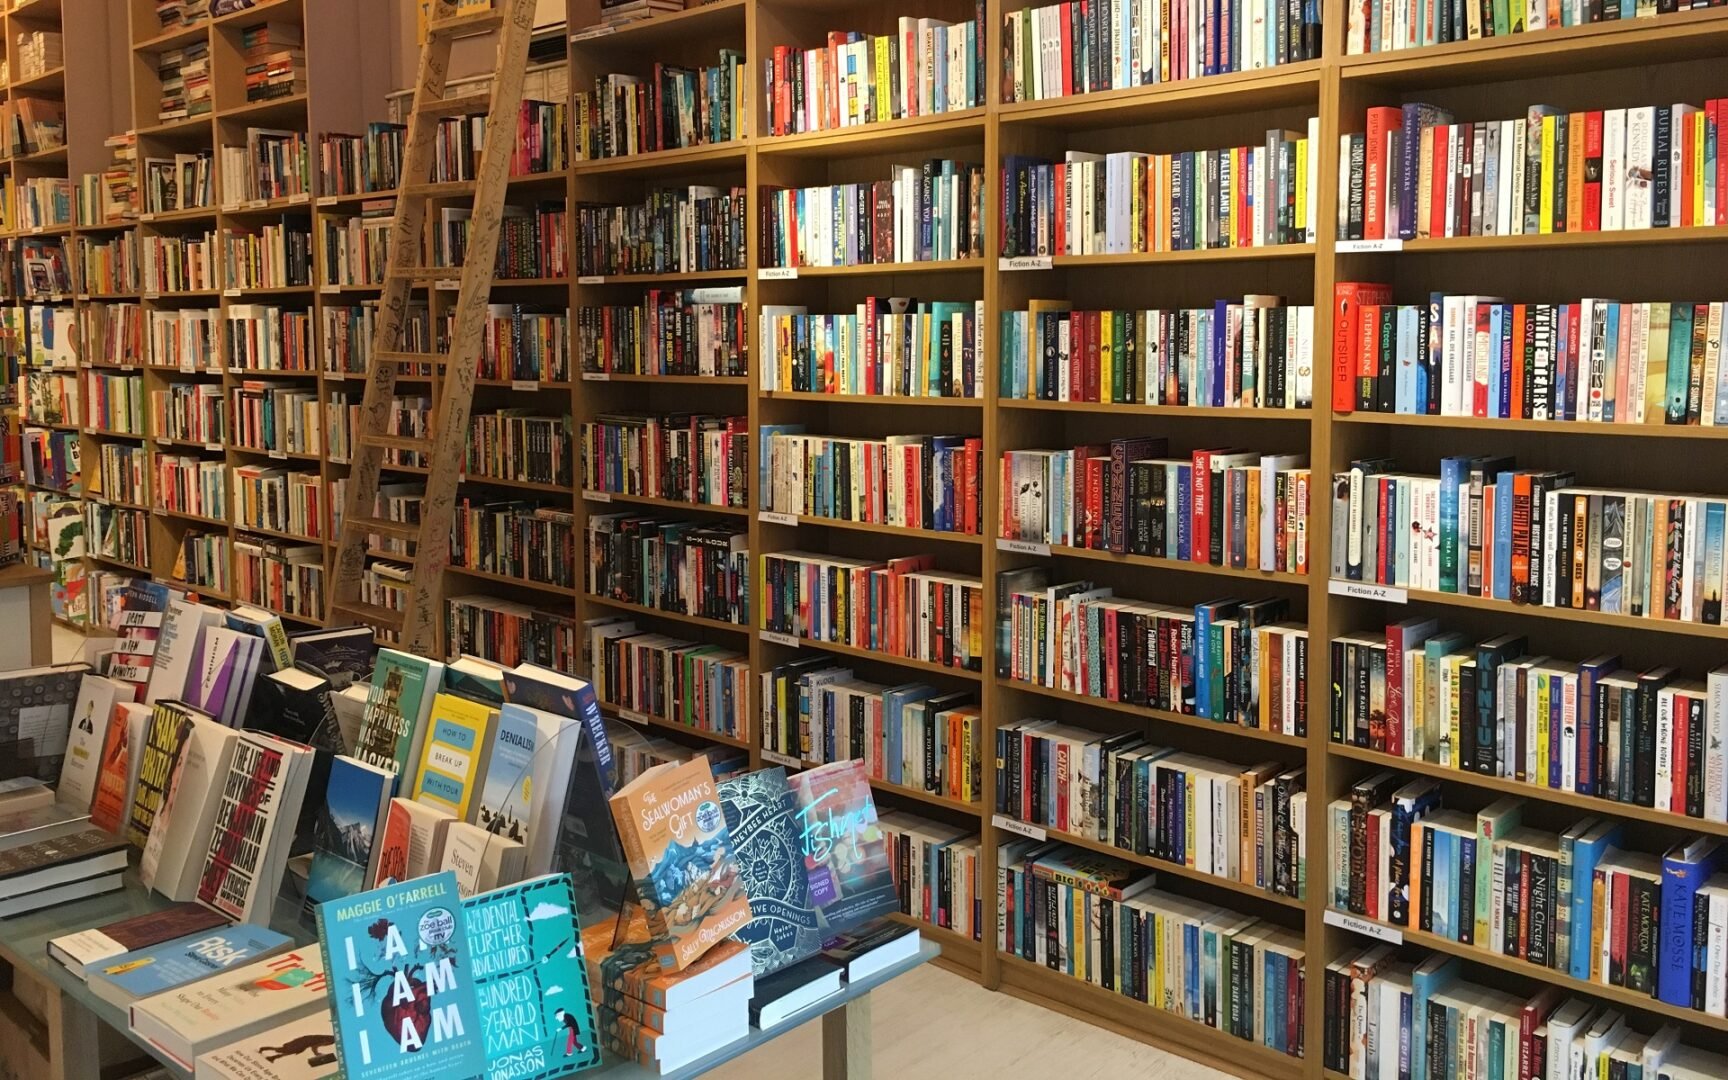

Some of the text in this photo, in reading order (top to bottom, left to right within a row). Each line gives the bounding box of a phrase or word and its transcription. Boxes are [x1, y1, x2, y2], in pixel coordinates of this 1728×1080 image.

[1657, 108, 1668, 195] BURIAL RITES
[923, 164, 931, 222] US AGAINST YOU
[1220, 153, 1230, 213] FALLEN LAND
[1608, 159, 1616, 209] Serious Sweet
[1363, 312, 1373, 352] STEPHEN
[1338, 319, 1349, 382] OUTSIDER
[1363, 353, 1373, 375] KING
[1534, 305, 1550, 409] WHITE TEARS
[1195, 456, 1204, 516] SHE'S NOT THERE
[1513, 494, 1529, 558] GRAFFITI PALACE
[1009, 543, 1027, 551] Fiction
[1347, 585, 1386, 598] Fiction A-Z
[125, 612, 146, 625] DEATH
[1210, 629, 1216, 638] OF
[128, 640, 140, 652] TEN
[269, 626, 281, 649] MORAN
[1148, 629, 1157, 666] Fatherland
[205, 636, 220, 690] FEMINISM
[1170, 628, 1178, 680] Robert Harris
[111, 666, 138, 679] MINUTES
[816, 675, 835, 686] KUDOS
[368, 684, 390, 706] YOUR
[1477, 652, 1492, 746] KINTU
[358, 724, 377, 746] WAS
[364, 703, 411, 738] HAPPINESS
[442, 727, 467, 742] HOW TO
[584, 702, 612, 767] WRECKER
[233, 742, 250, 774] THE
[435, 752, 463, 769] BREAK UP
[965, 744, 971, 753] GO
[965, 755, 971, 764] MY
[259, 790, 272, 806] OF
[426, 778, 459, 796] WITH YOUR
[216, 798, 268, 846] BENJAMIN
[762, 798, 788, 821] HEART
[1005, 821, 1032, 834] Fiction A-Z
[1341, 834, 1347, 844] OF
[210, 825, 261, 875] ZEPHANIAH
[450, 850, 475, 877] Steven
[222, 868, 251, 900] LYRICIST
[809, 879, 830, 891] SIGNED
[814, 887, 830, 898] COPY
[1054, 873, 1075, 886] BIG
[219, 890, 246, 910] WRITER
[336, 899, 384, 923] MAGGIE
[386, 882, 448, 909] O'FARRELL
[769, 904, 811, 927] OPENINGS
[1533, 876, 1547, 947] Night Circus
[466, 900, 521, 936] ACCIDENTAL
[773, 924, 792, 934] Helen
[1343, 918, 1382, 936] Fiction A-Z
[1639, 890, 1651, 953] KATE MORTON
[1672, 884, 1687, 971] KATE MOSSE
[186, 936, 249, 967] Risk
[345, 937, 357, 970] I
[468, 924, 526, 957] FURTHER
[472, 944, 529, 977] ADVENTURES
[352, 957, 458, 1017] I AM
[480, 975, 533, 1010] HUNDRED
[1231, 945, 1239, 1022] MA JIAN THE DARK ROAD
[359, 1002, 466, 1065] I AM
[432, 1046, 449, 1057] WITH
[451, 1040, 472, 1051] DEATH
[487, 1022, 540, 1054] MAN
[488, 1045, 544, 1071] JONAS
[1400, 1027, 1408, 1073] CITY OF LIES
[1521, 1041, 1529, 1074] BIZARRE
[490, 1056, 546, 1080] JONASSON
